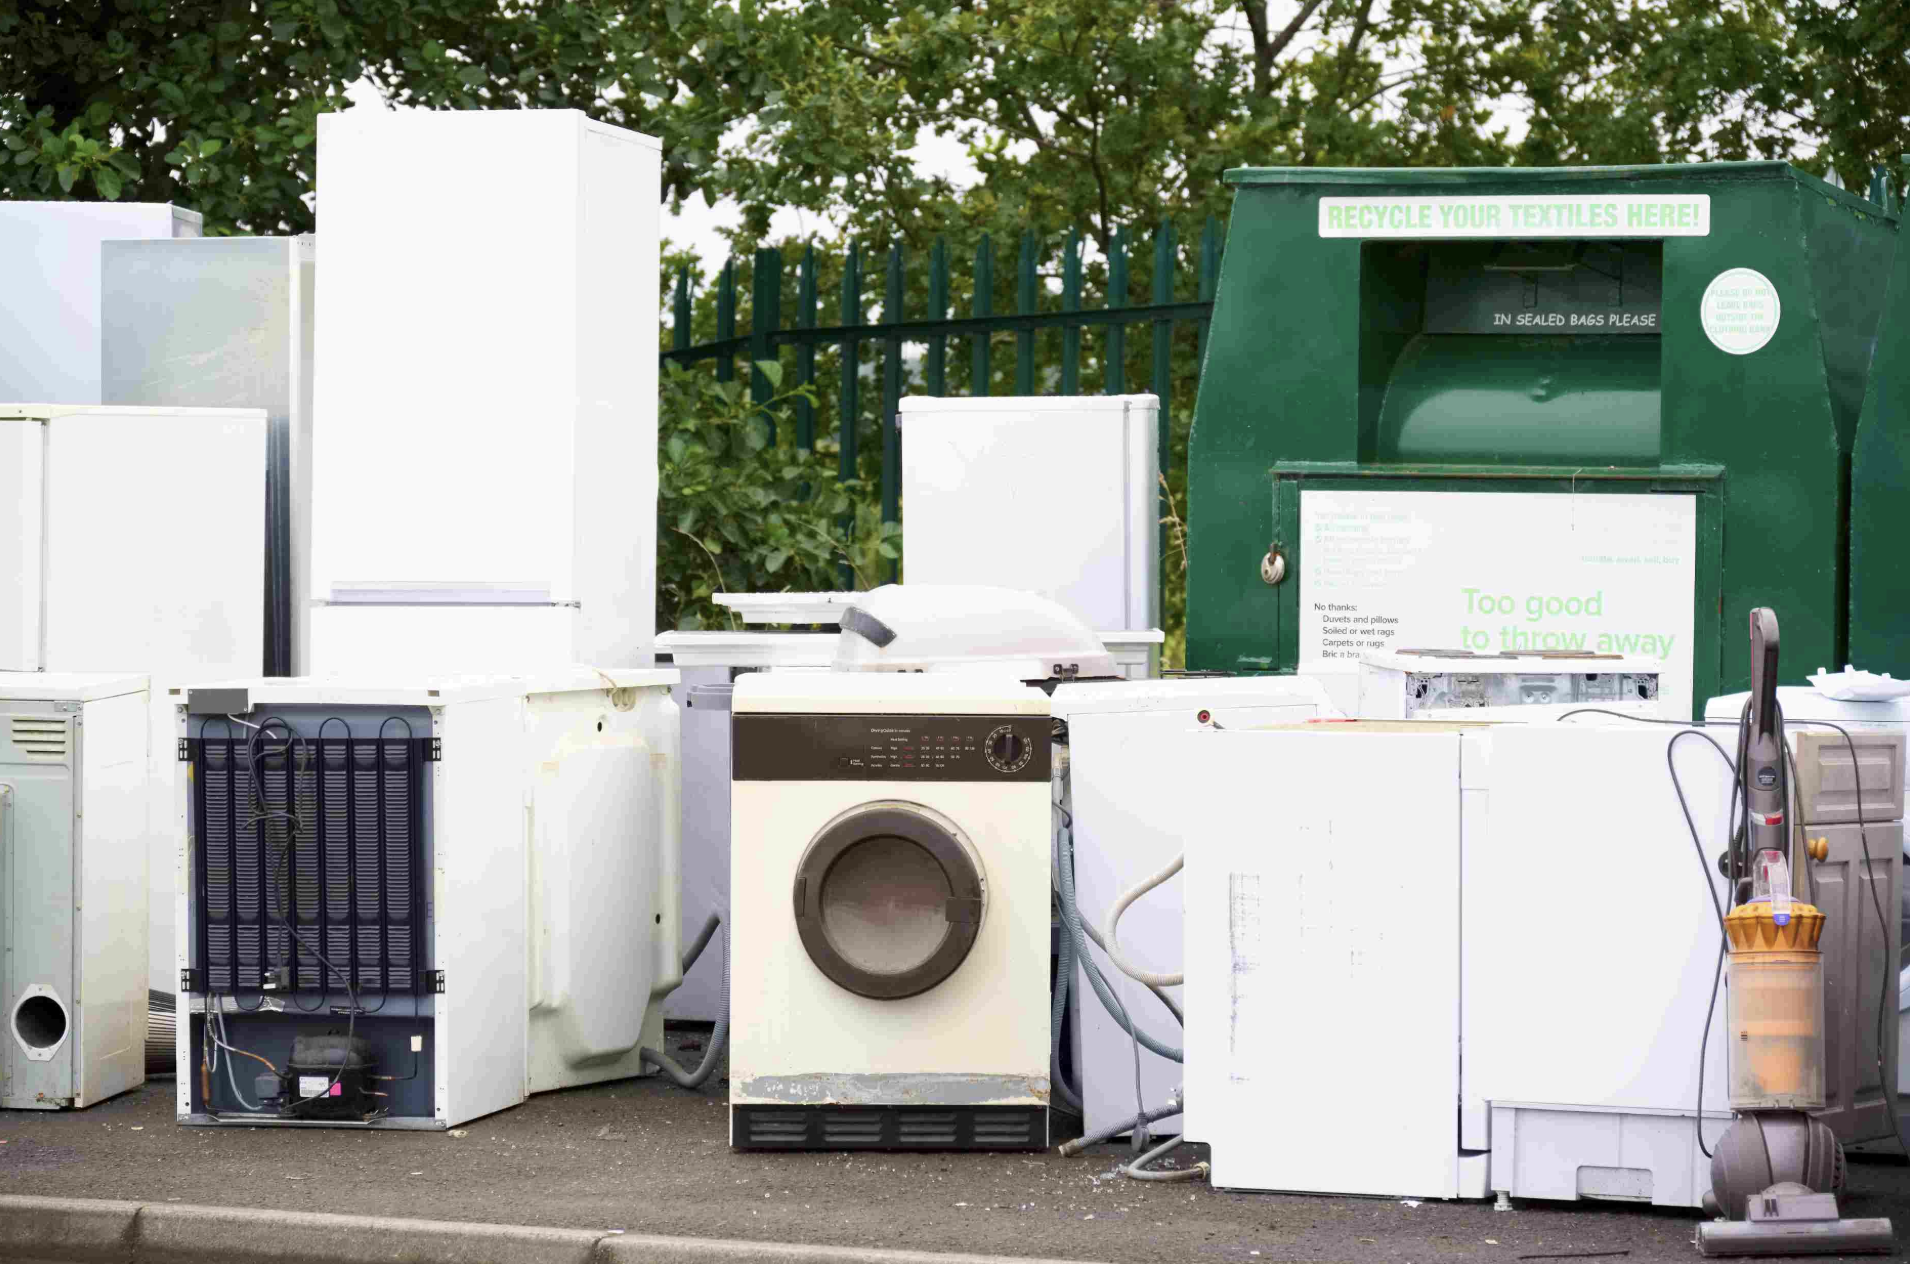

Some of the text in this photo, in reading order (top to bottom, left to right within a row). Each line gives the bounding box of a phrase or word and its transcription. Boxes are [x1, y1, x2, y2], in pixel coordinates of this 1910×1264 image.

[1328, 203, 1699, 229] RECYCLE YOUR TEXTILES HERE!
[1493, 313, 1657, 327] IN SEALED BAGS PLEASE
[1314, 602, 1358, 612] No thanks:
[1460, 587, 1603, 622] Too good
[1322, 614, 1399, 626] Duvets and pillows
[1322, 626, 1395, 638] Soiled or wet rags
[1322, 638, 1385, 649] Carpets or rugs
[1460, 625, 1676, 660] to throw away
[1322, 649, 1338, 659] Bric
[1346, 650, 1361, 659] bra
